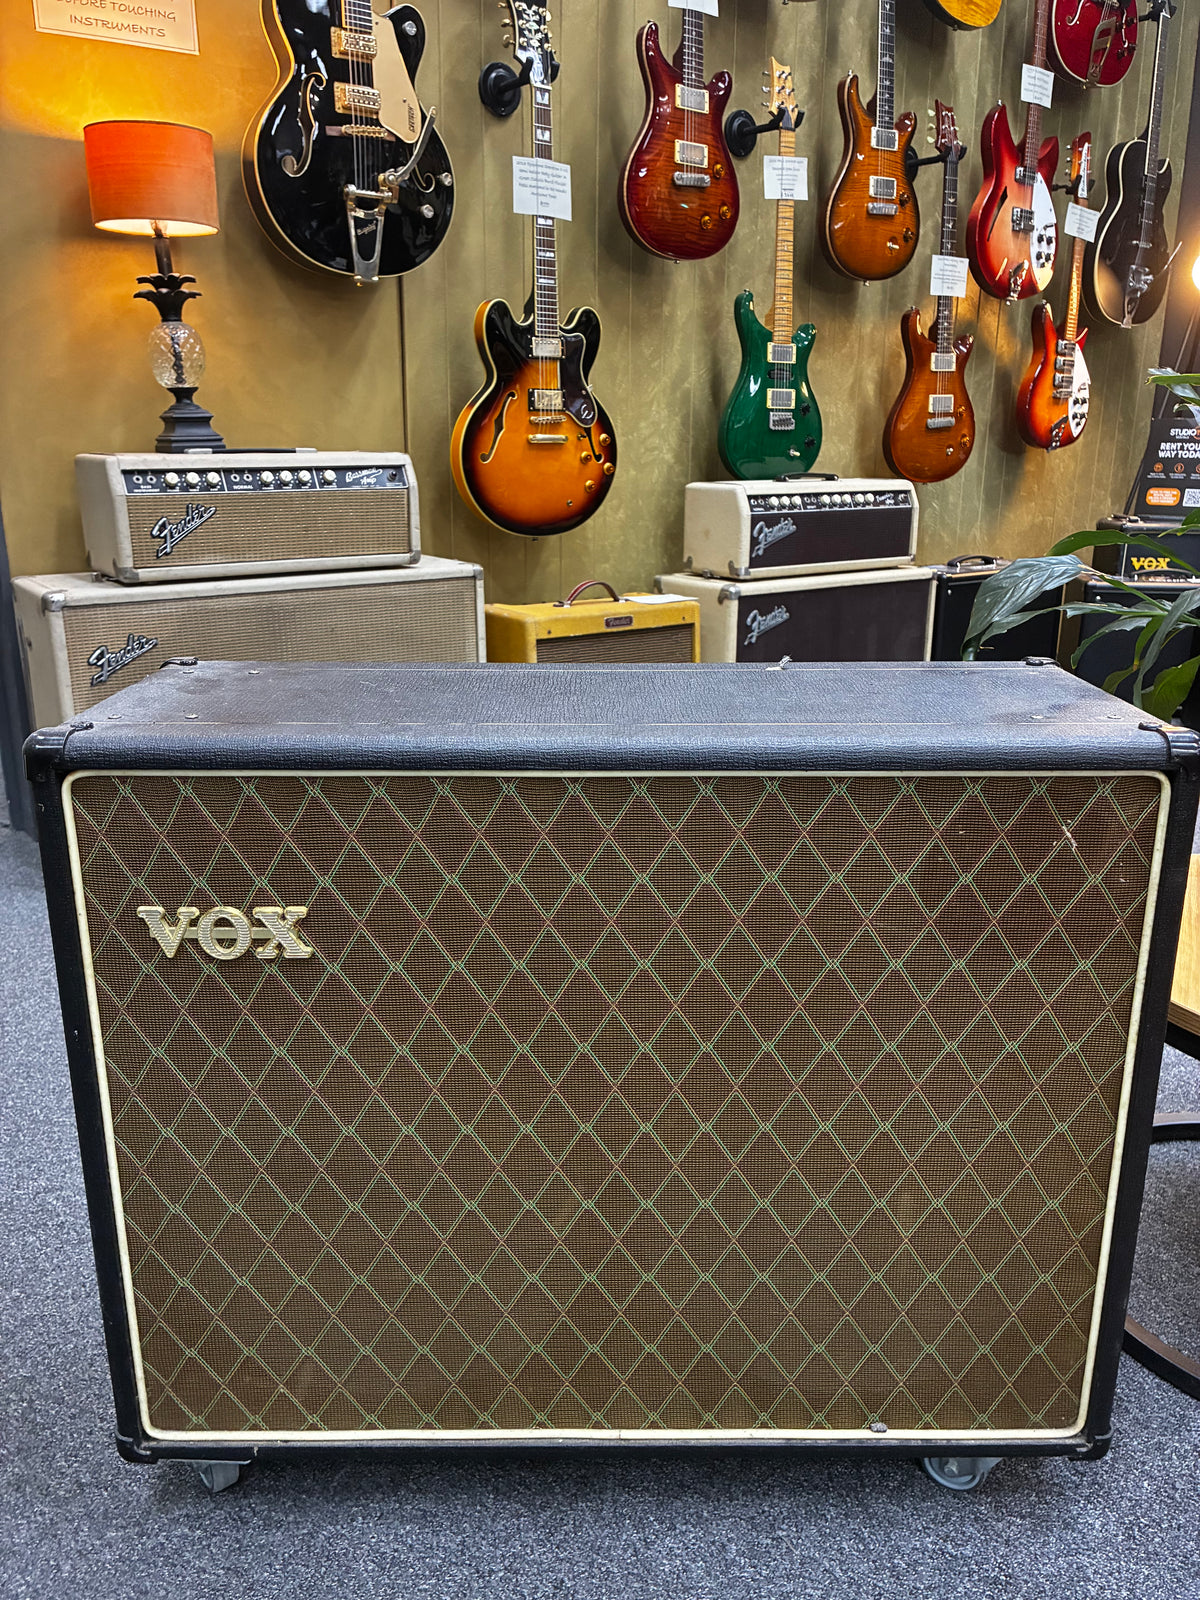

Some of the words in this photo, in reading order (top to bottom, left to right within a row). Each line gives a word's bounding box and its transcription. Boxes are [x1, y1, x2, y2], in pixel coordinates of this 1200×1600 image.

[109, 1, 176, 22] TOUCHING
[70, 14, 166, 37] INSTRUMENTS
[1170, 428, 1197, 436] STUDIO
[1158, 450, 1177, 459] WAY
[1160, 442, 1182, 451] RENT
[151, 503, 217, 559] Fender
[751, 517, 797, 558] Fender
[1130, 556, 1171, 571] VOX
[744, 605, 790, 646] Fender
[88, 633, 159, 687] Fender
[137, 905, 313, 960] VOX
